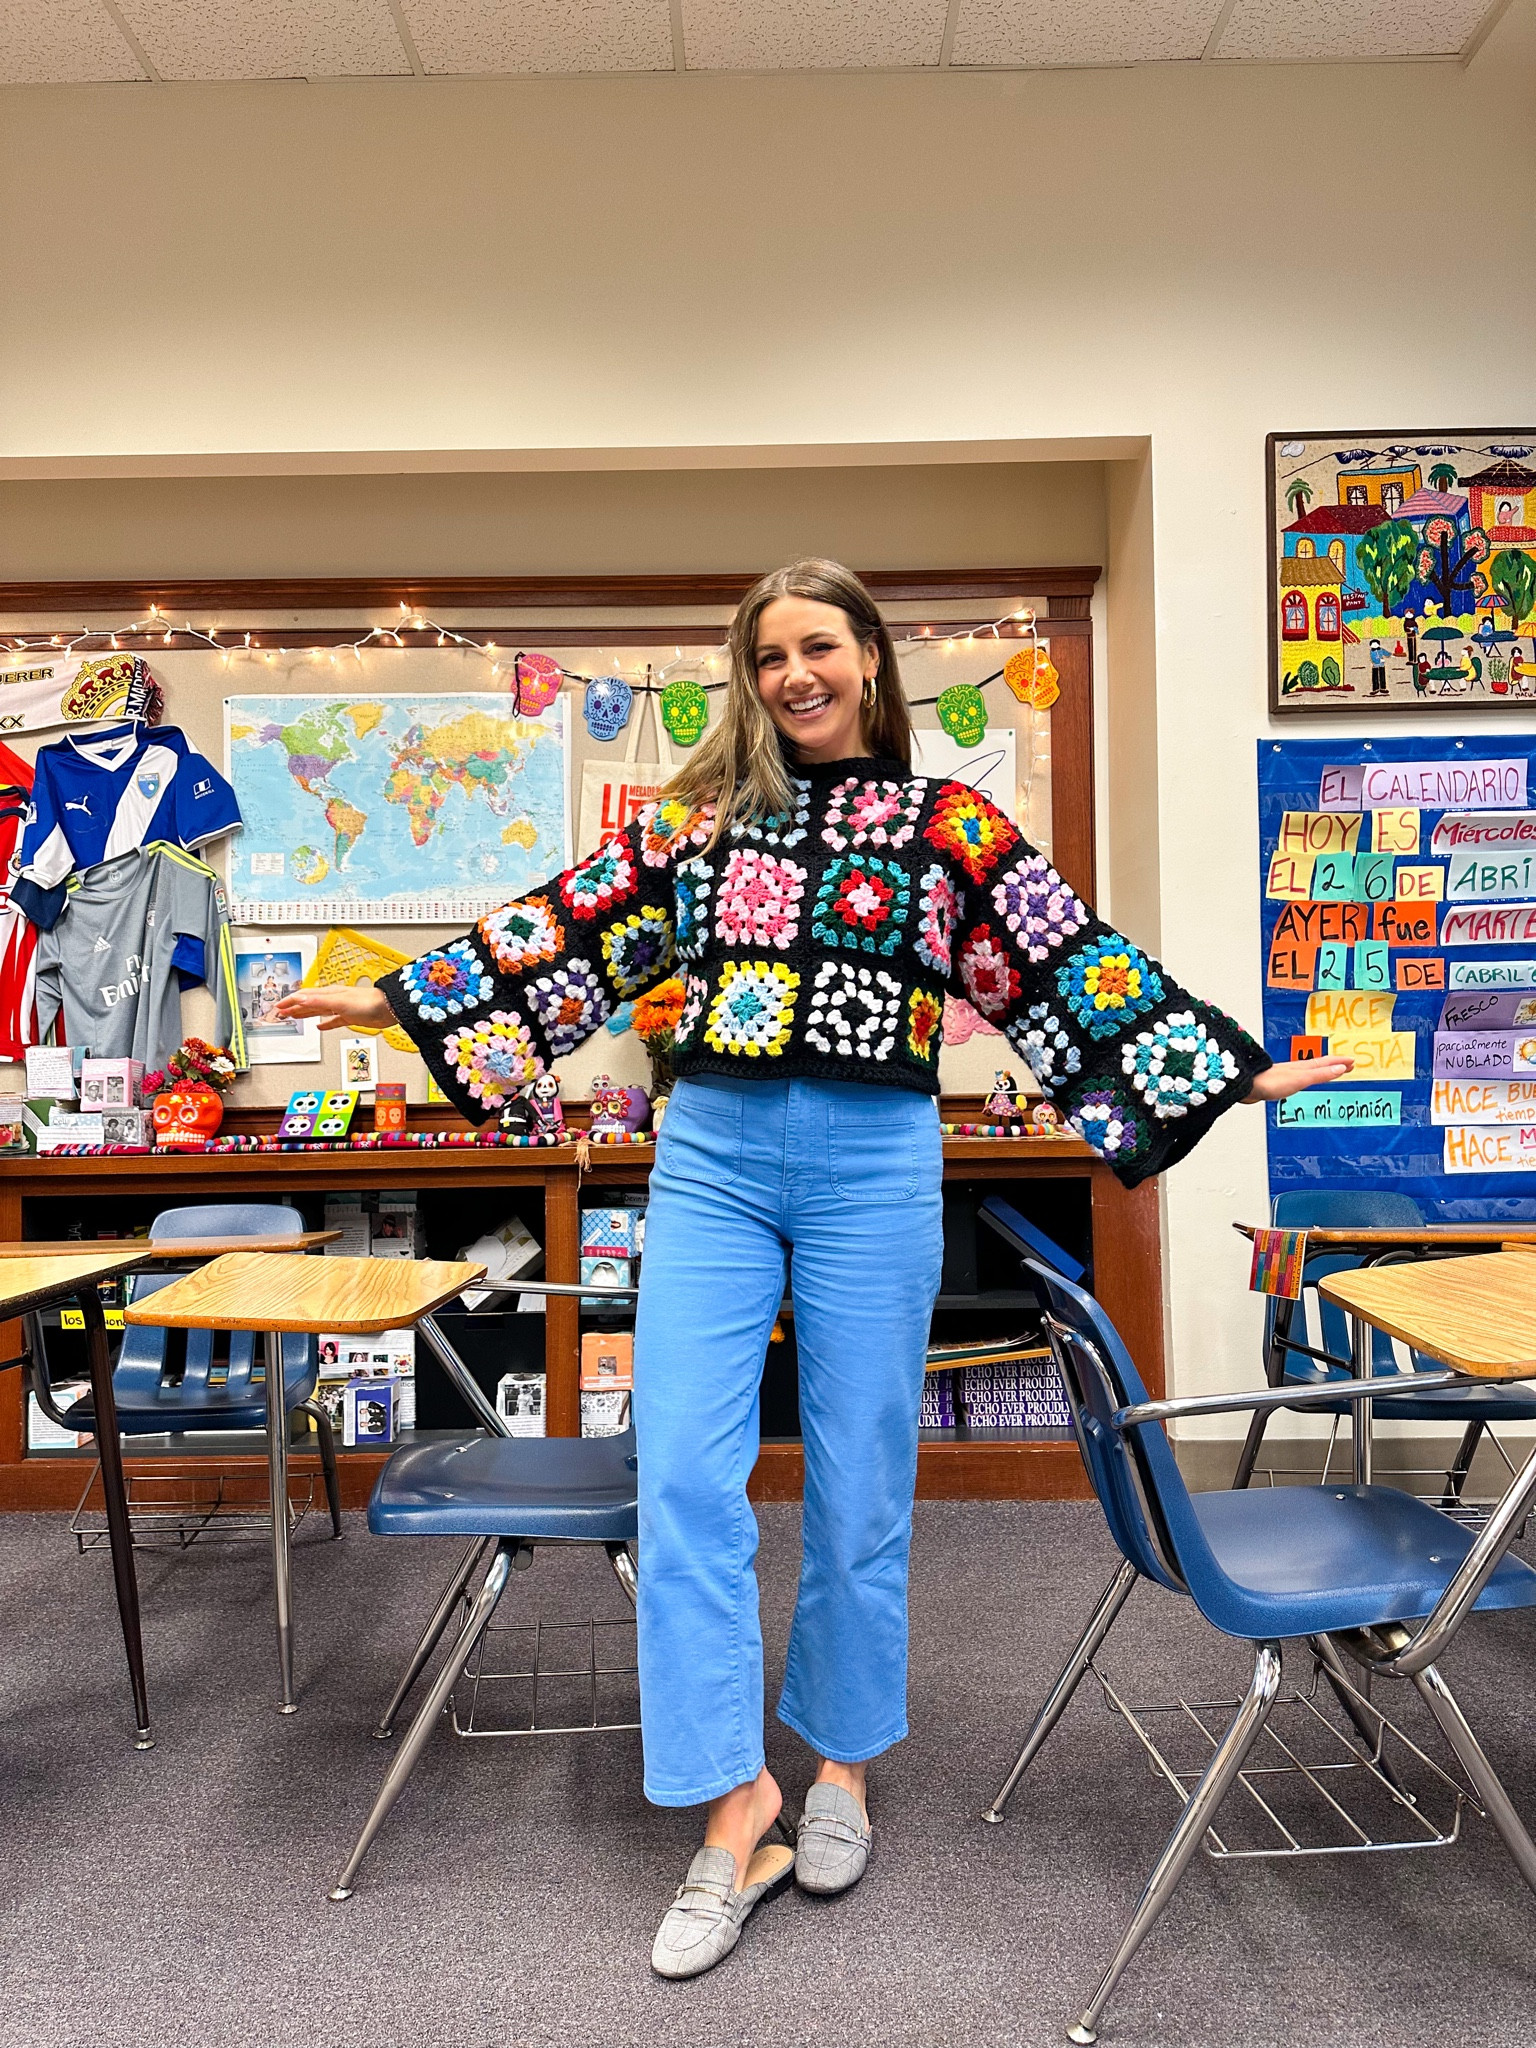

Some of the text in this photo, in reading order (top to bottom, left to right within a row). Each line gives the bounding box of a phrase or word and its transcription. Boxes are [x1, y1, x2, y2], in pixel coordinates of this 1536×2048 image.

[1321, 767, 1520, 804] EL CALENDARIO
[1283, 813, 1360, 853] HOY
[1378, 811, 1417, 853] ES
[1269, 857, 1306, 893] EL
[1399, 872, 1436, 898] DE
[1275, 903, 1360, 942] AYER
[1378, 906, 1431, 941] fue
[1272, 950, 1310, 979] EL
[1403, 963, 1442, 986] DE
[1309, 995, 1499, 1031] HACE FRESCO
[1437, 1038, 1508, 1057] parcialmente
[1445, 1054, 1512, 1070] NUBLADO
[1434, 1080, 1499, 1114] HACE
[1279, 1098, 1393, 1124] En mi opinión
[1447, 1128, 1513, 1168] HACE
[63, 1314, 83, 1326] los
[964, 1376, 1063, 1391] ECHO EVER PROUDLY
[965, 1366, 993, 1379] ECHO
[993, 1366, 1018, 1378] EVER
[964, 1389, 1064, 1403] ECHO EVER PROUDLY
[973, 1402, 1000, 1415] ECHO
[1000, 1402, 1026, 1414] EVER
[970, 1413, 1070, 1427] ECHO EVER PROUDLY
